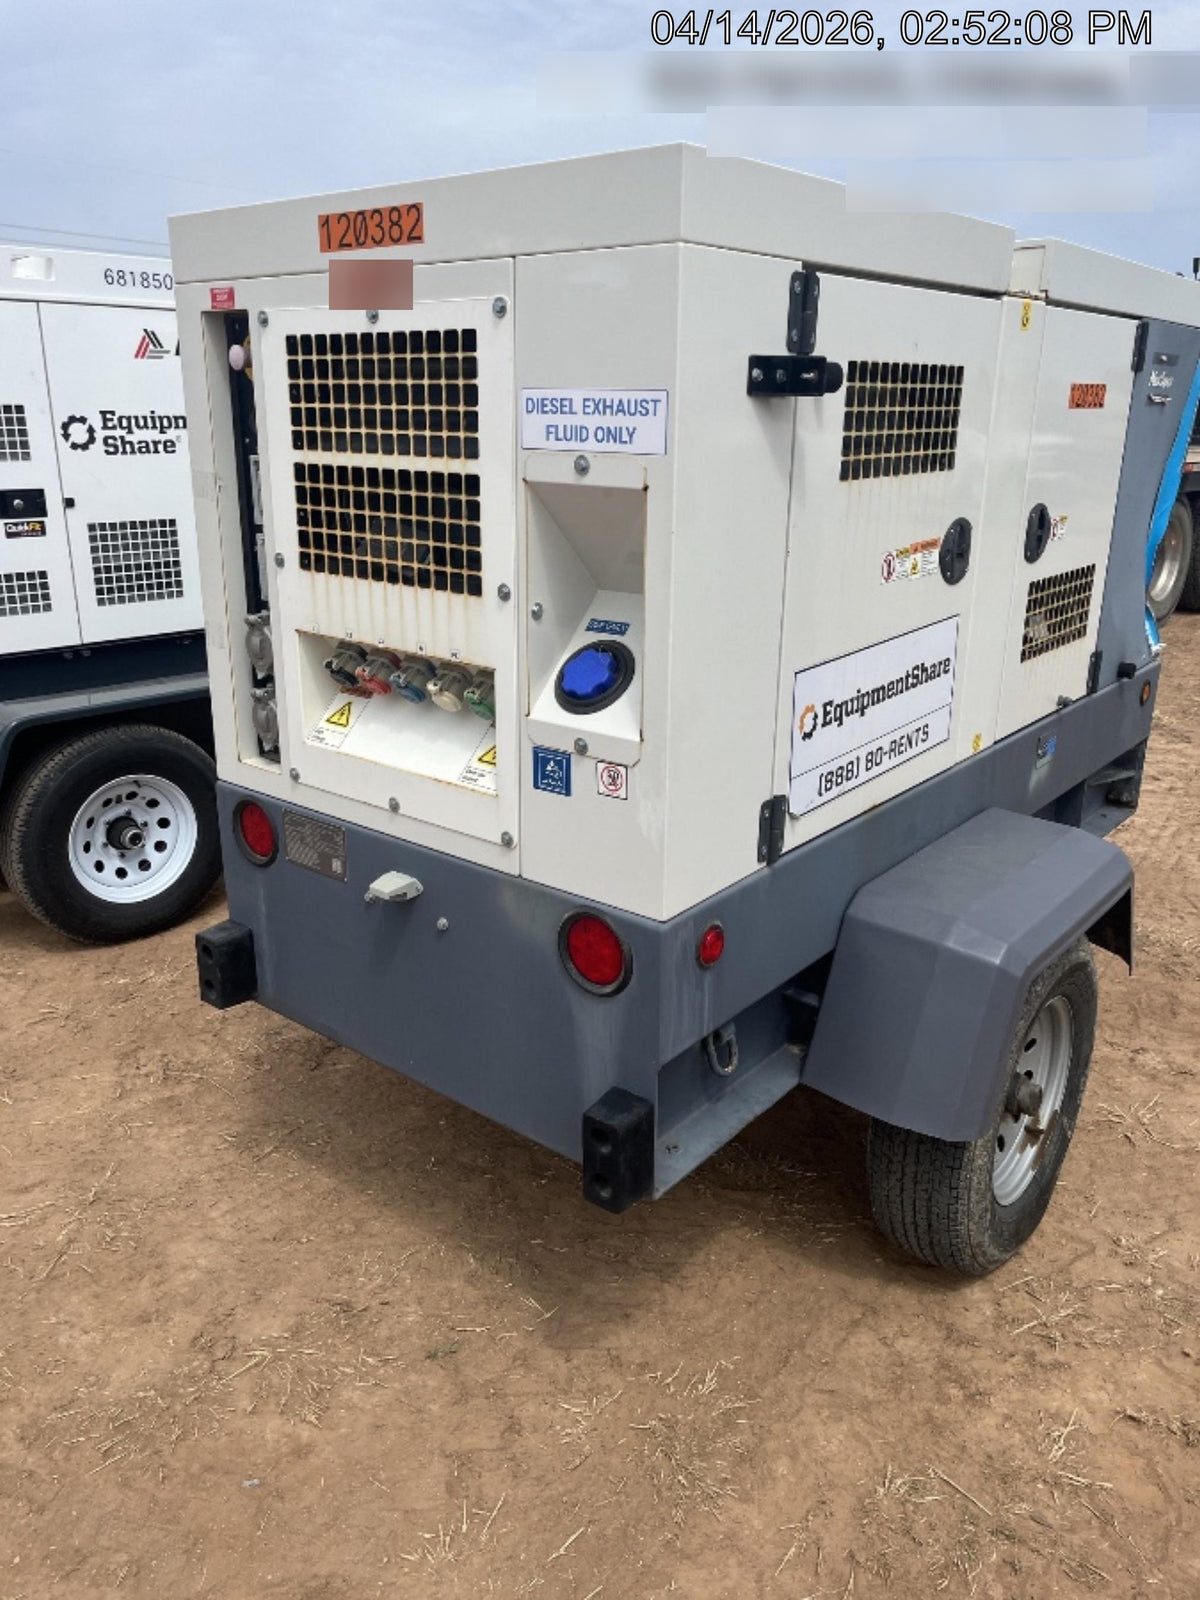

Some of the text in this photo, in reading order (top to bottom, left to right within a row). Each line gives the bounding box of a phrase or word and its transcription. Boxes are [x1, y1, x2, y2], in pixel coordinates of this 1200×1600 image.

[321, 203, 422, 249] 120382
[104, 268, 173, 290] 681850
[525, 397, 662, 417] DIESEL EXHAUST
[545, 424, 637, 445] FLUID ONLY
[821, 657, 951, 728] EquipmentShare
[818, 754, 860, 797] (888)
